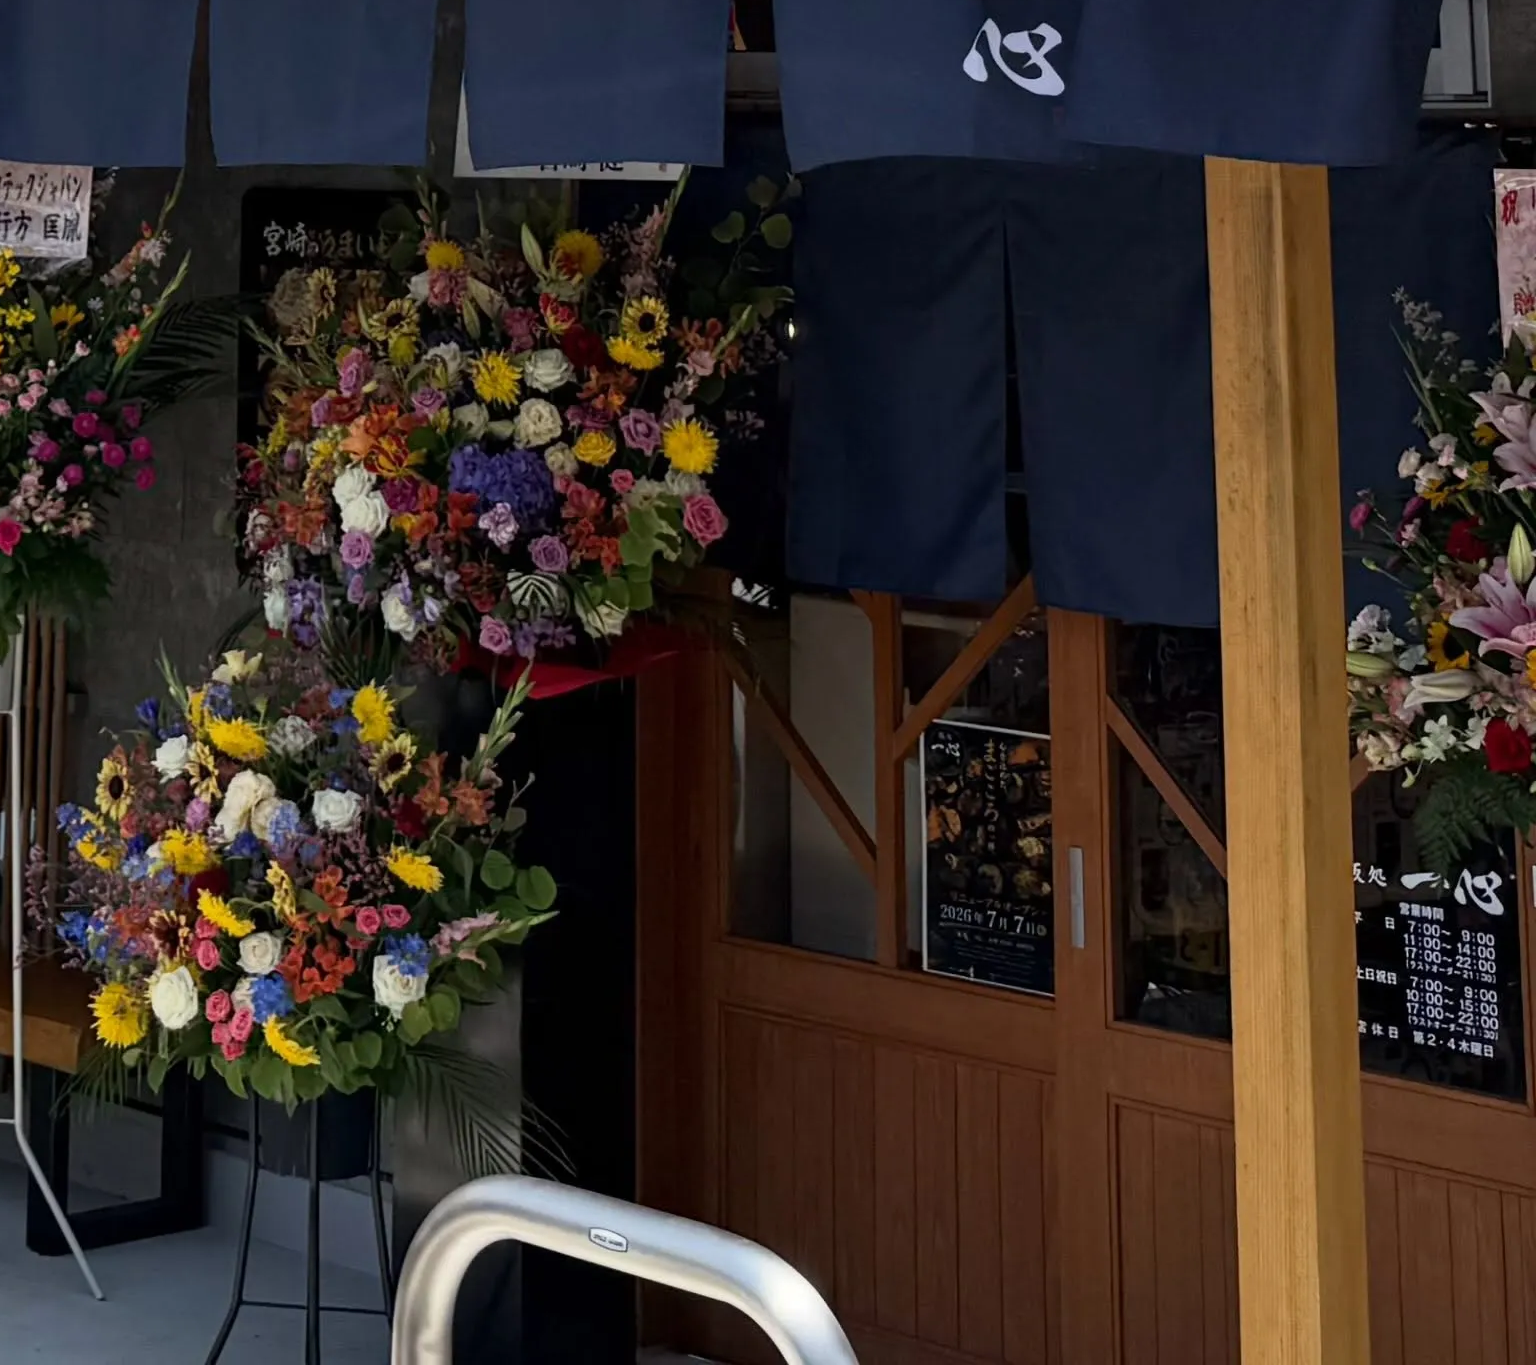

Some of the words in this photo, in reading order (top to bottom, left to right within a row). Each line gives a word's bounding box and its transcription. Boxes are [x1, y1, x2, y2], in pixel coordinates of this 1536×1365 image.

[1461, 929, 1496, 947] 9:00
[1456, 943, 1496, 961] 14:00
[1455, 956, 1497, 975] 22:00
[1463, 985, 1498, 1004] 9:00
[1459, 999, 1499, 1018] 15:00
[1457, 1011, 1500, 1031] 22:00
